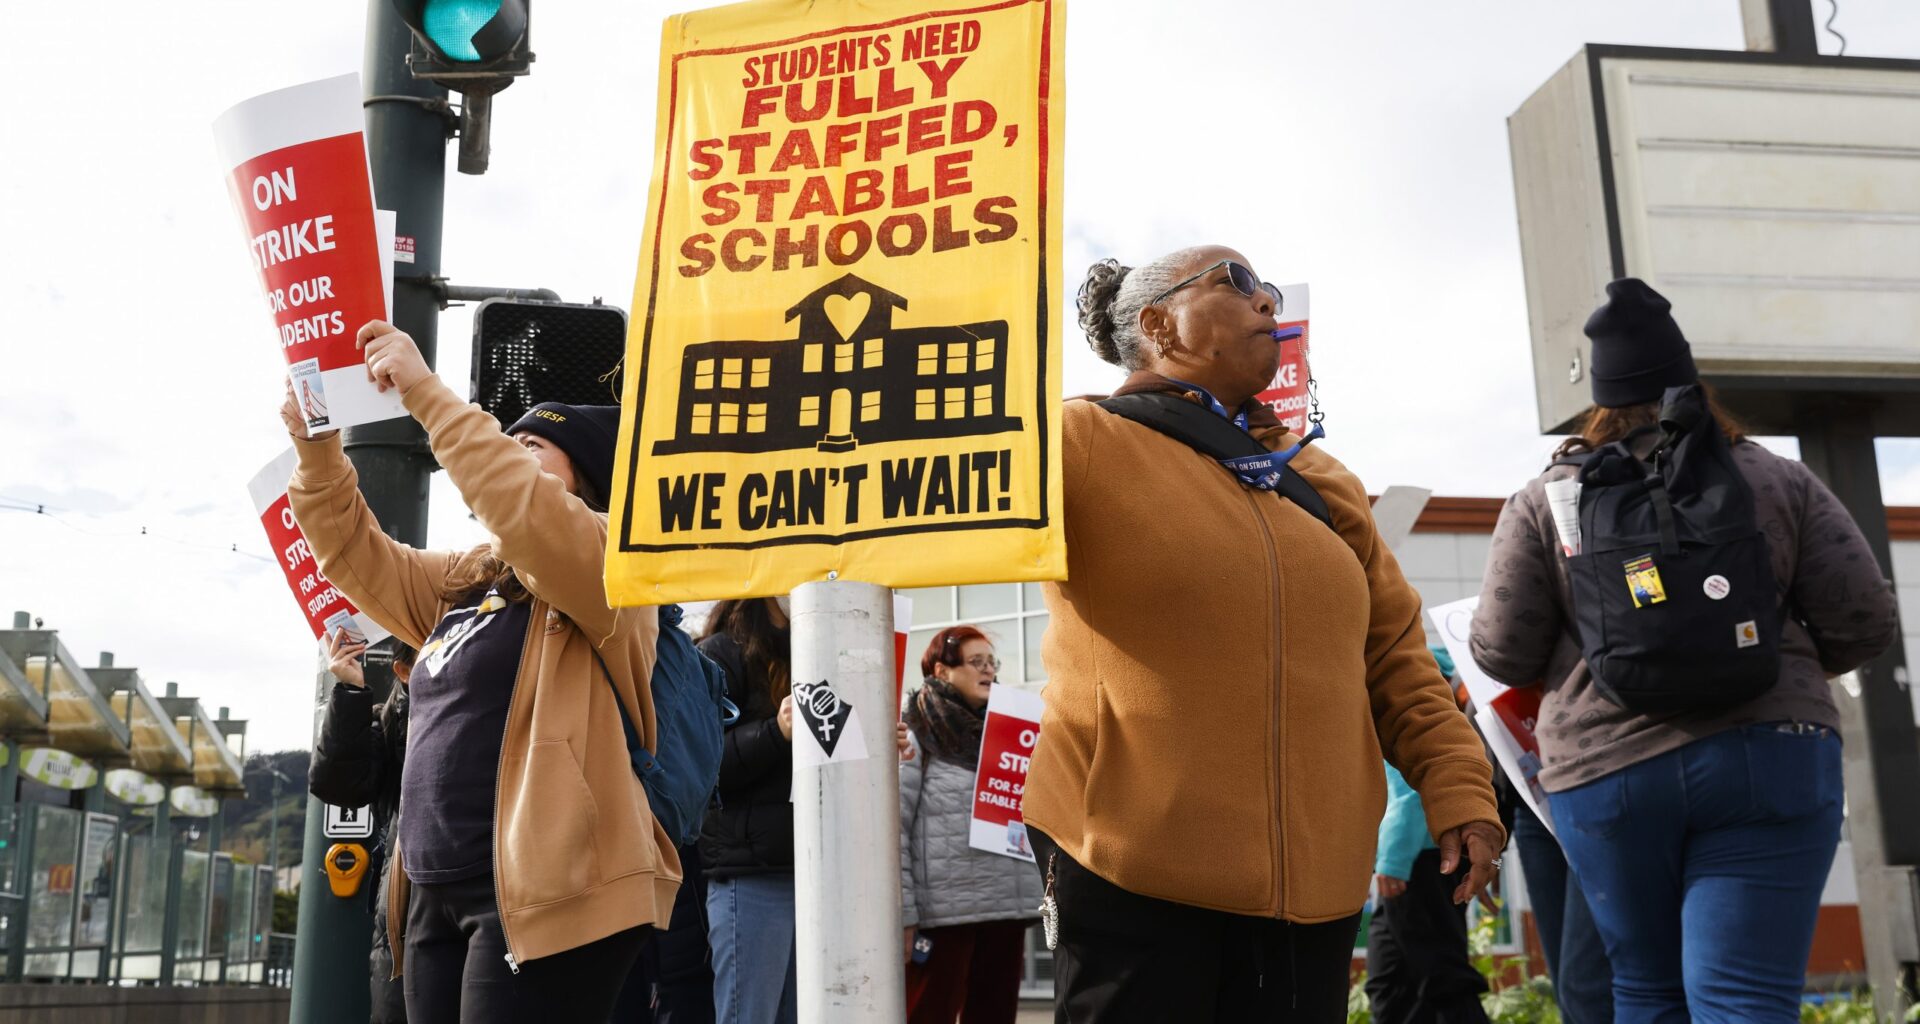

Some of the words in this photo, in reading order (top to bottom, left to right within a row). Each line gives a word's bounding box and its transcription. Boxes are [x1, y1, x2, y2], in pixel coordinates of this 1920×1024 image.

[742, 33, 892, 88] STUDENTS
[901, 19, 981, 63] NEED
[741, 56, 969, 129] FULLY
[688, 99, 1019, 182] STAFFED,
[253, 166, 297, 212] ON
[701, 149, 974, 226] STABLE
[678, 195, 1018, 278] SCHOOLS
[268, 288, 288, 315] OR
[289, 275, 335, 307] OUR
[277, 310, 345, 349] UDENTS
[1266, 363, 1297, 390] IKE
[536, 409, 566, 423] UESF
[1268, 394, 1308, 413] CHOOLS
[1249, 460, 1272, 470] STRIKE
[658, 472, 726, 534] WE
[738, 463, 868, 531] CAN'T
[881, 449, 1011, 519] WAIT!
[281, 507, 297, 530] O
[285, 538, 312, 571] STR
[299, 573, 317, 596] FOR
[308, 588, 346, 617] STUDEN
[1019, 729, 1040, 748] O
[998, 751, 1031, 774] STR
[988, 777, 1010, 793] FOR
[979, 791, 1017, 811] STABLE
